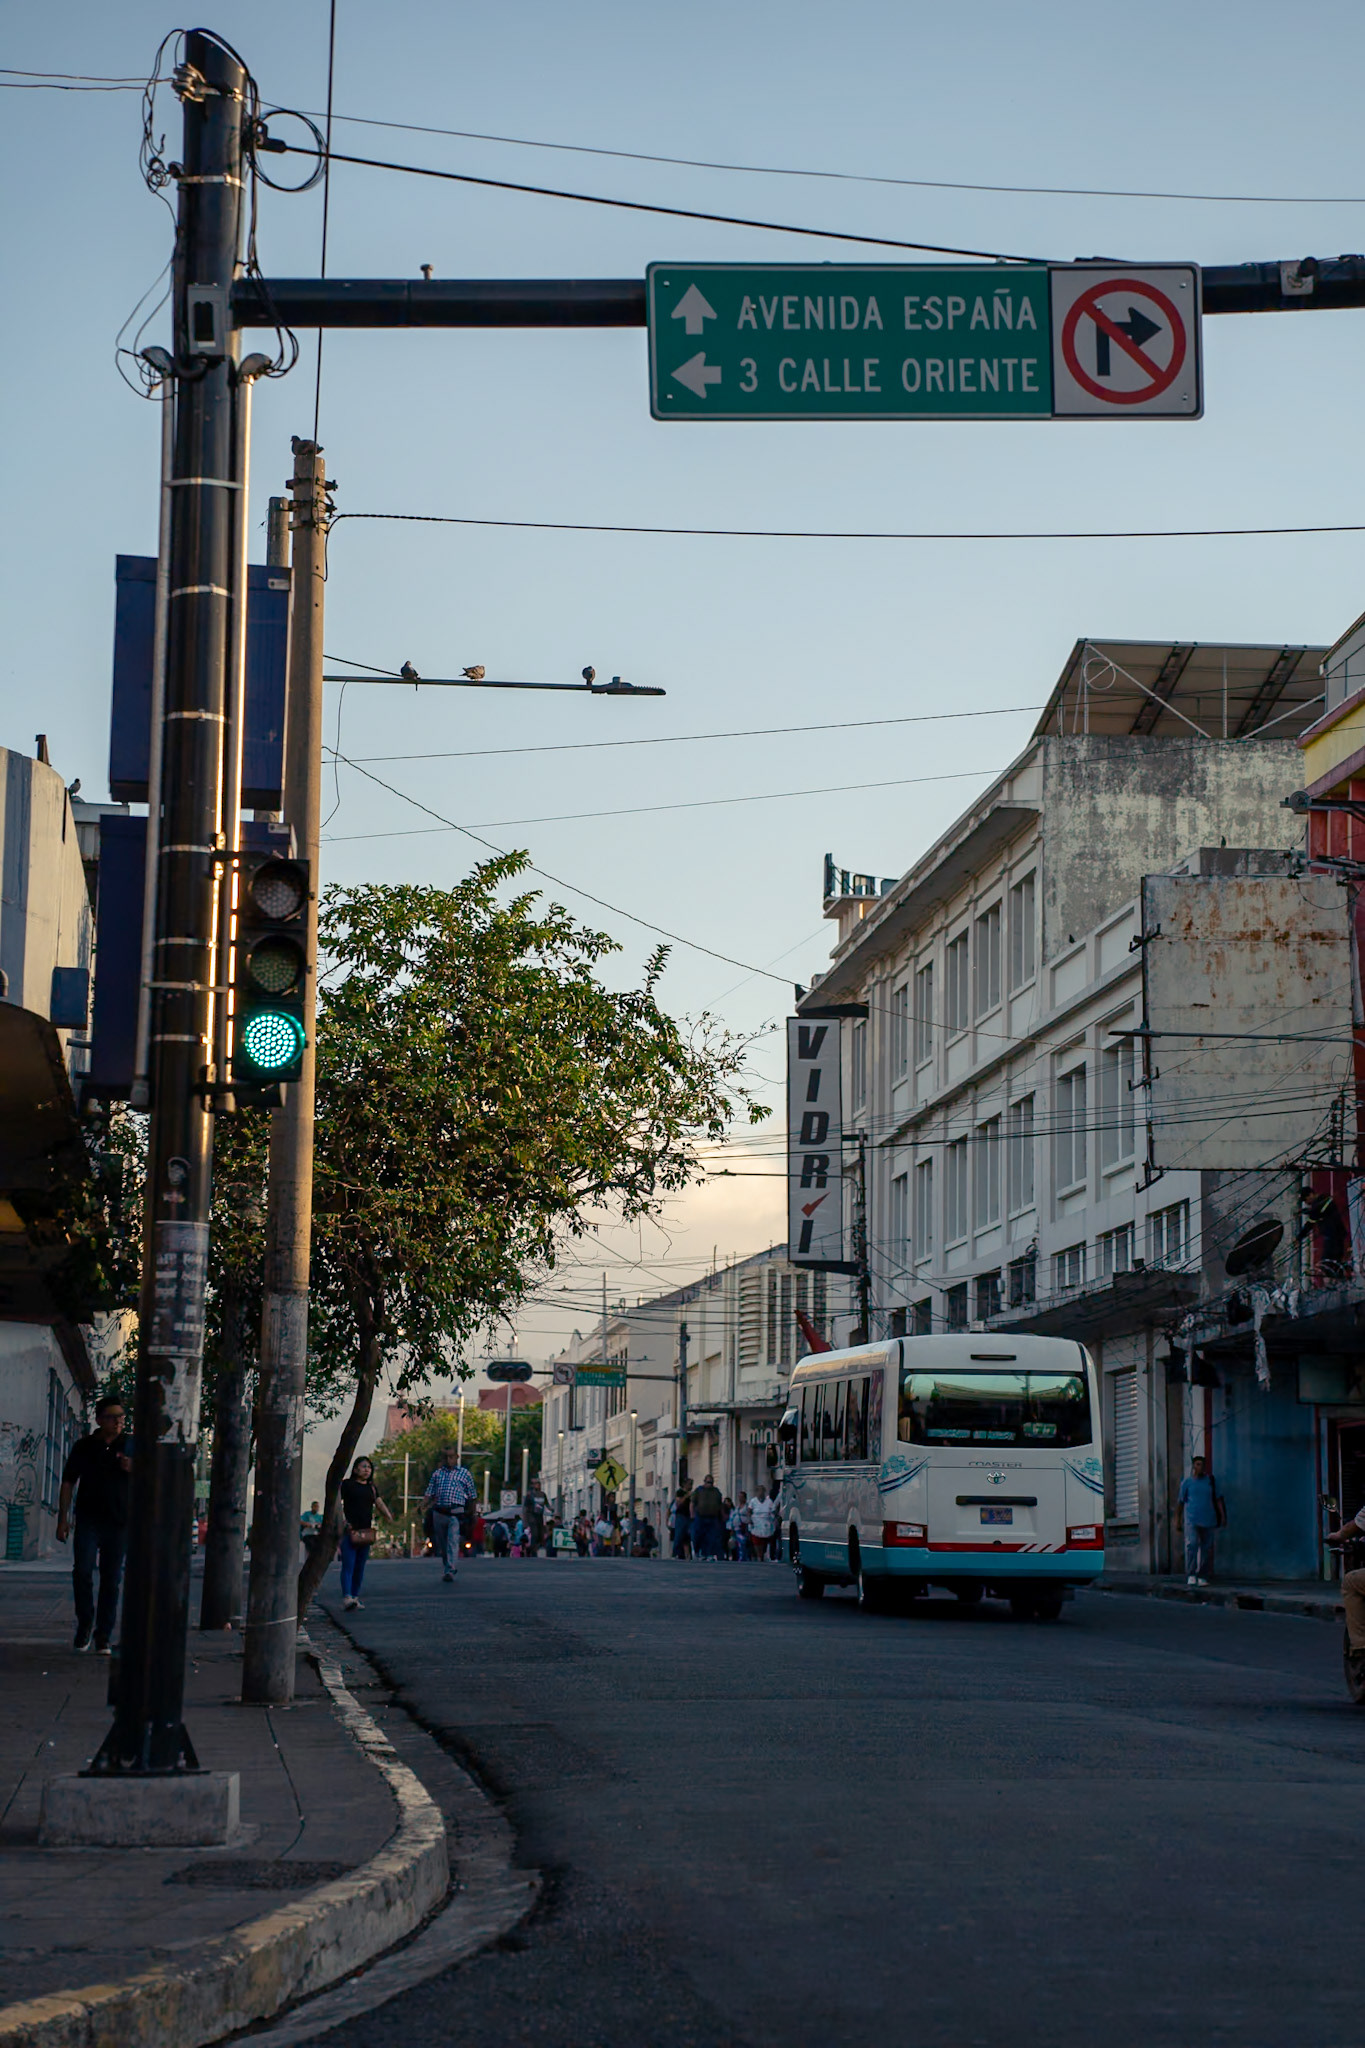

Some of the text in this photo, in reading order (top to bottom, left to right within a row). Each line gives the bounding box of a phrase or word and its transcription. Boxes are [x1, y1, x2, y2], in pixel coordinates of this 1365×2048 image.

[737, 288, 1038, 330] AVENIDA ESPAÑA
[739, 357, 1040, 393] 3 CALLE ORIENTE
[797, 1025, 832, 1254] VIDRI
